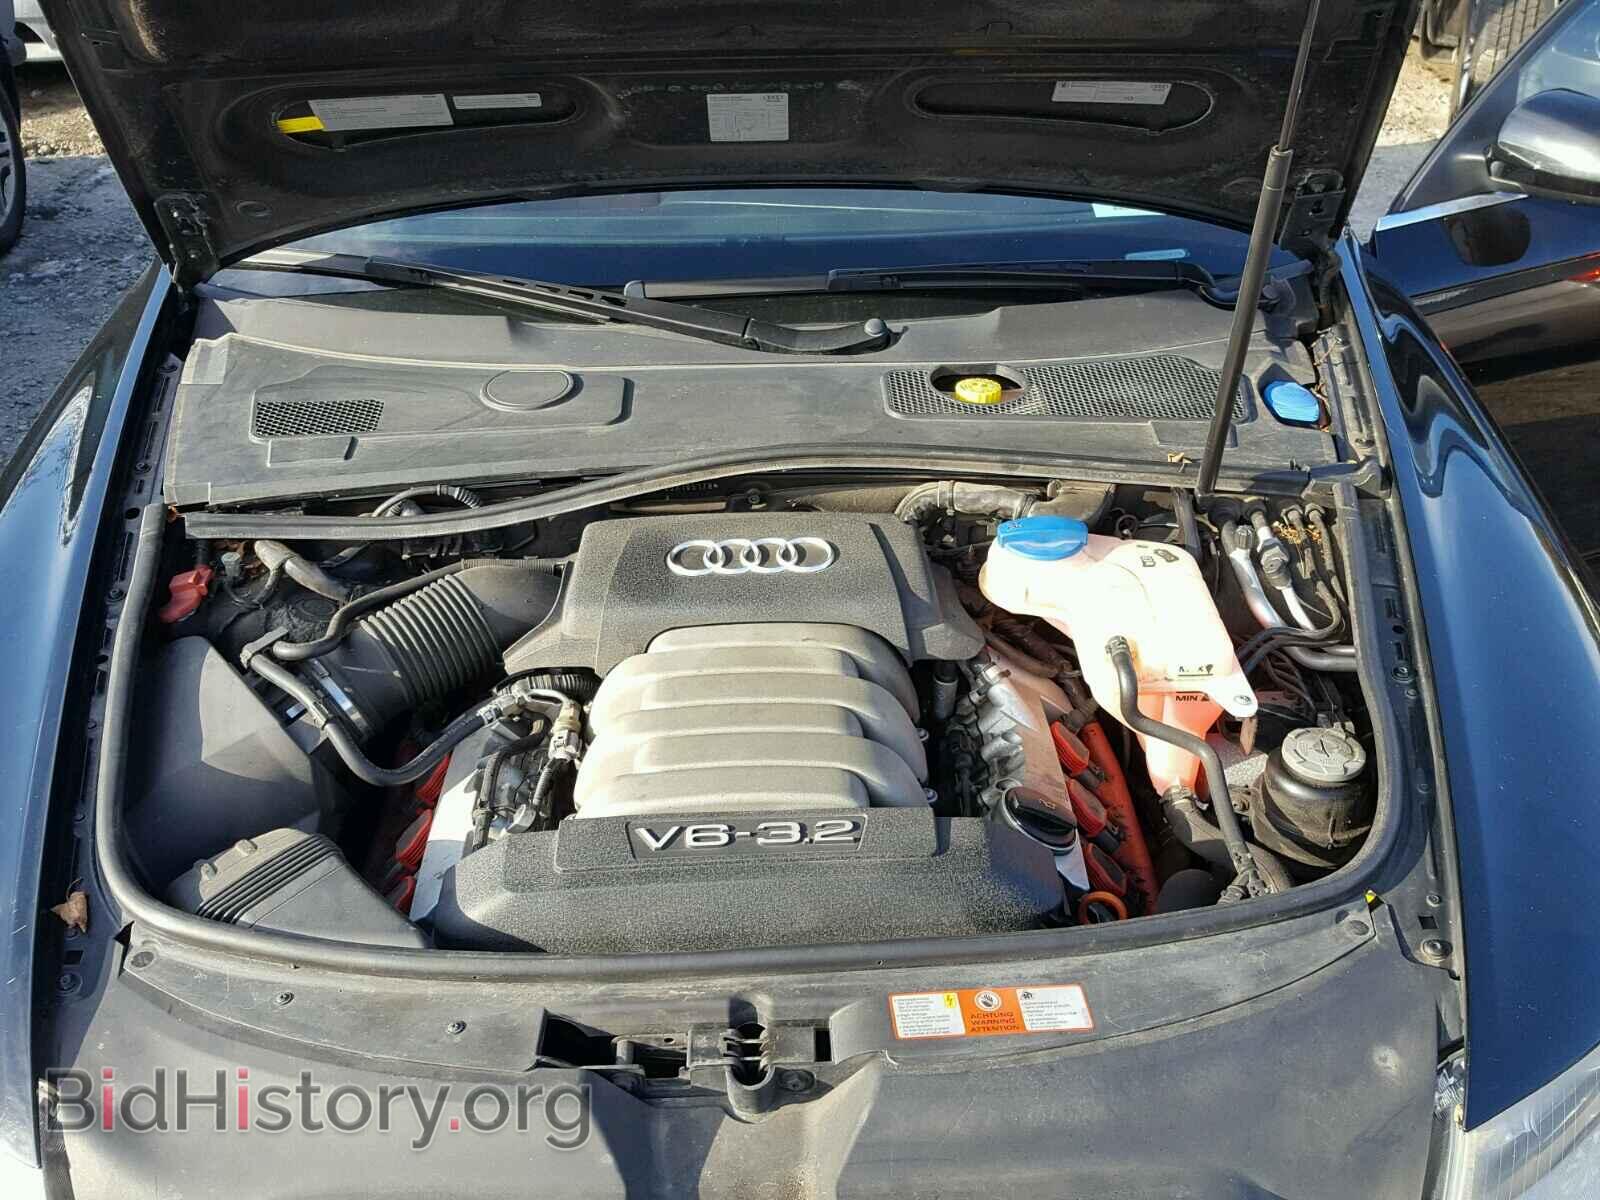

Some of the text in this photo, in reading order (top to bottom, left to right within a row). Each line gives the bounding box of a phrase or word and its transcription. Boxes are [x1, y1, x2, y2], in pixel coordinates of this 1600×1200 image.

[635, 819, 860, 851] V6-3.2
[970, 1011, 1014, 1019] ACHTUNG
[970, 1018, 1016, 1026] WARNING
[970, 1025, 1020, 1033] ATTENTION
